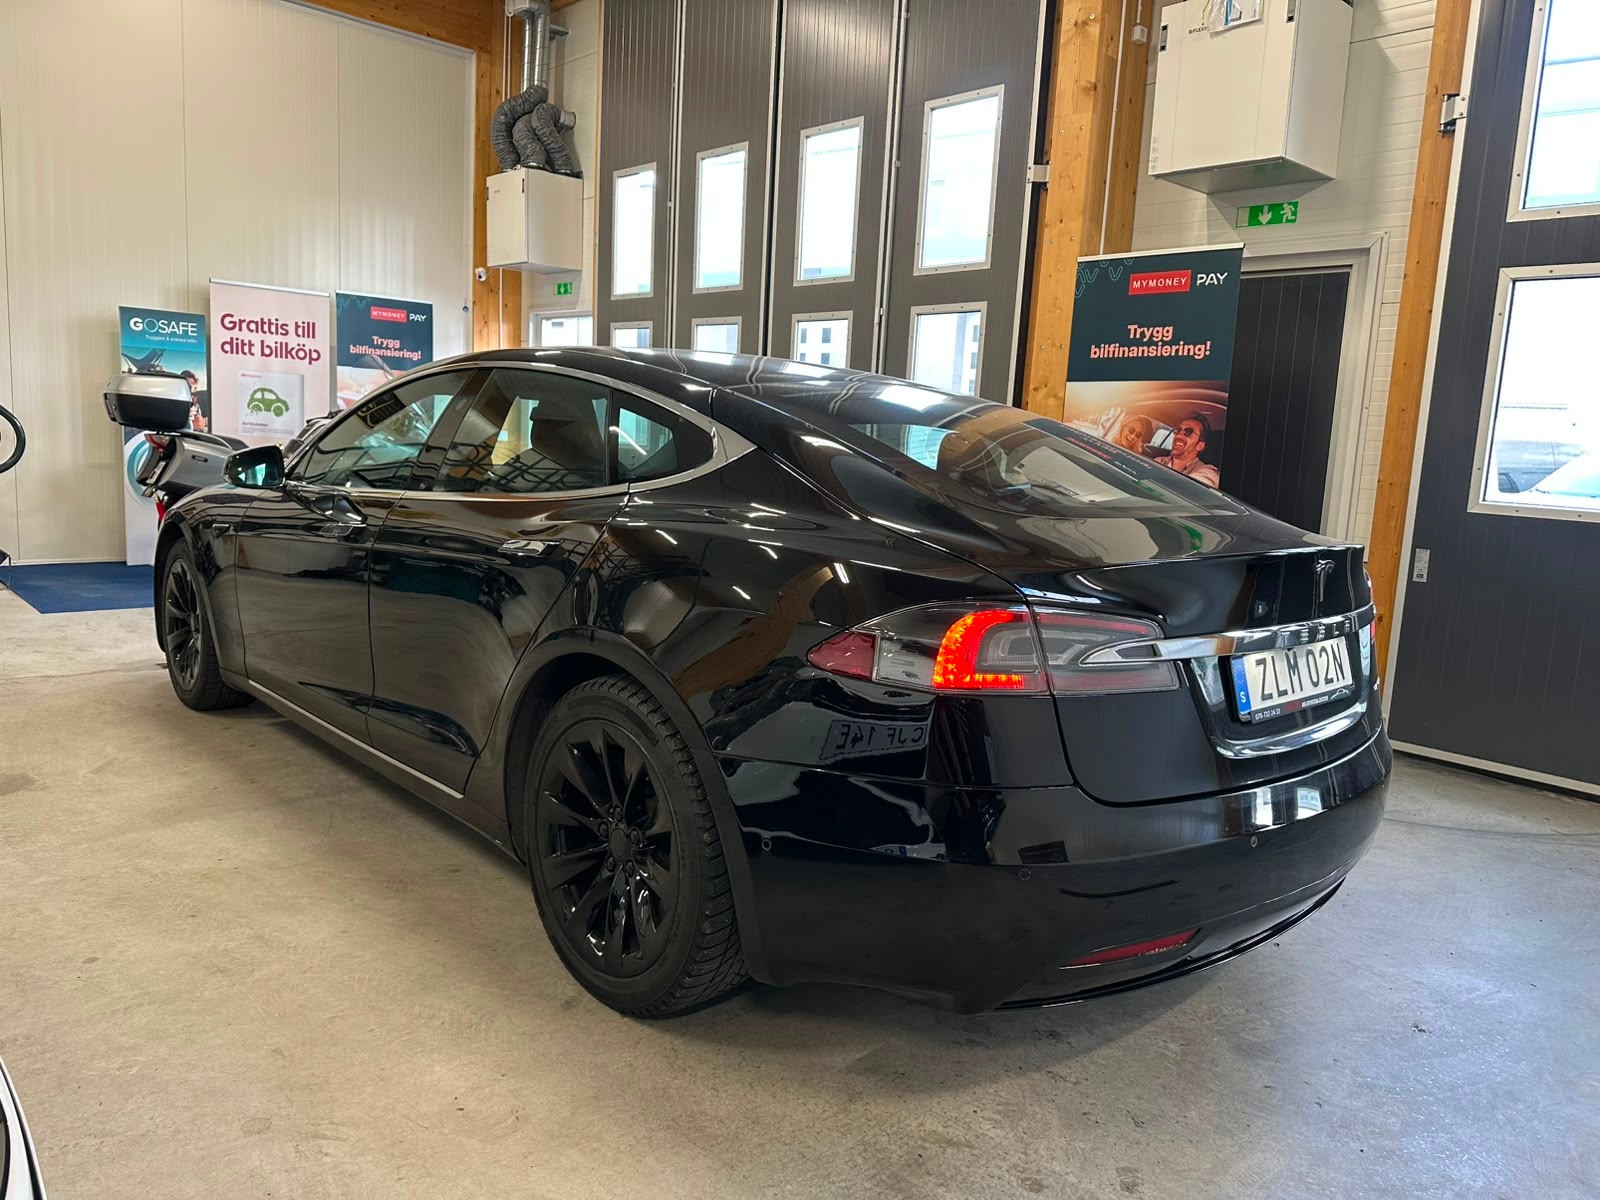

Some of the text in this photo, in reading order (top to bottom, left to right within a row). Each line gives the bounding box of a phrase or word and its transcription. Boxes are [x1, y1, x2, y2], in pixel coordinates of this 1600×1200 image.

[1132, 272, 1228, 289] MYMONEY PAY
[372, 310, 427, 322] MYMONEY PAY
[129, 317, 198, 336] GOSAFE
[220, 313, 316, 339] Grattis till
[1128, 324, 1174, 342] Trygg
[220, 337, 321, 365] ditt bilköp
[372, 336, 401, 348] Trygg
[1090, 341, 1212, 359] bilfinansiering!
[350, 345, 421, 361] bilfinansiering!
[1255, 642, 1345, 701] ZLM 02N
[1240, 691, 1246, 703] S
